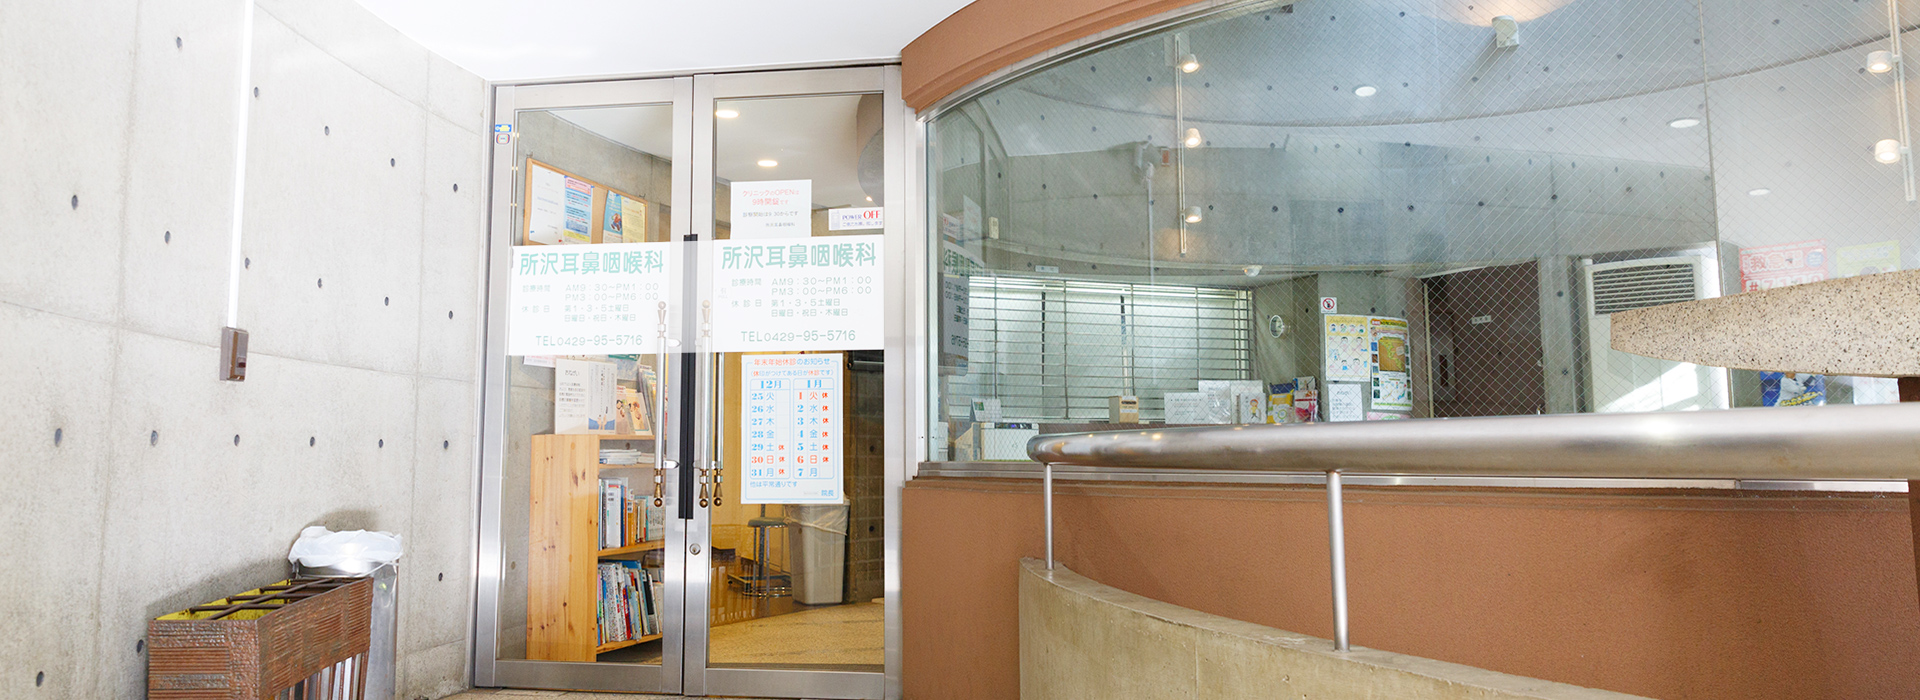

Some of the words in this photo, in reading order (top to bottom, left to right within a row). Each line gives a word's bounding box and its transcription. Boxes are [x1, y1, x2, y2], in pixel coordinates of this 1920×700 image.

[863, 210, 881, 220] OFF
[722, 242, 876, 270] 所沢耳鼻咽喉科
[520, 250, 664, 276] 所沢耳鼻咽喉科
[732, 278, 762, 287] 診療時間
[522, 285, 550, 293] 診療時間
[731, 299, 762, 308] 休診日
[522, 305, 550, 313] 休診日
[754, 358, 830, 366] 年末年始休診のお知らせ
[760, 380, 782, 389] 12月
[807, 380, 822, 388] 1月
[752, 392, 764, 400] 25
[766, 392, 774, 400] 火
[810, 391, 818, 400] 火
[752, 405, 764, 413] 26
[766, 404, 774, 413] 水
[797, 405, 804, 413] 2
[810, 404, 818, 413] 水
[752, 418, 764, 426] 27
[766, 417, 774, 426] 木
[797, 417, 804, 425] 3
[810, 417, 818, 425] 木
[766, 430, 774, 438] 金
[798, 430, 804, 438] 4
[810, 429, 818, 438] 金
[766, 443, 774, 451] 土
[797, 443, 804, 451] 5
[810, 442, 818, 451] 土
[752, 456, 764, 464] 30
[766, 455, 774, 464] 日
[797, 456, 804, 464] 6
[810, 455, 818, 464] 日
[766, 468, 774, 477] 月
[797, 468, 804, 476] 7
[810, 468, 818, 477] 月
[820, 489, 834, 497] 院長
